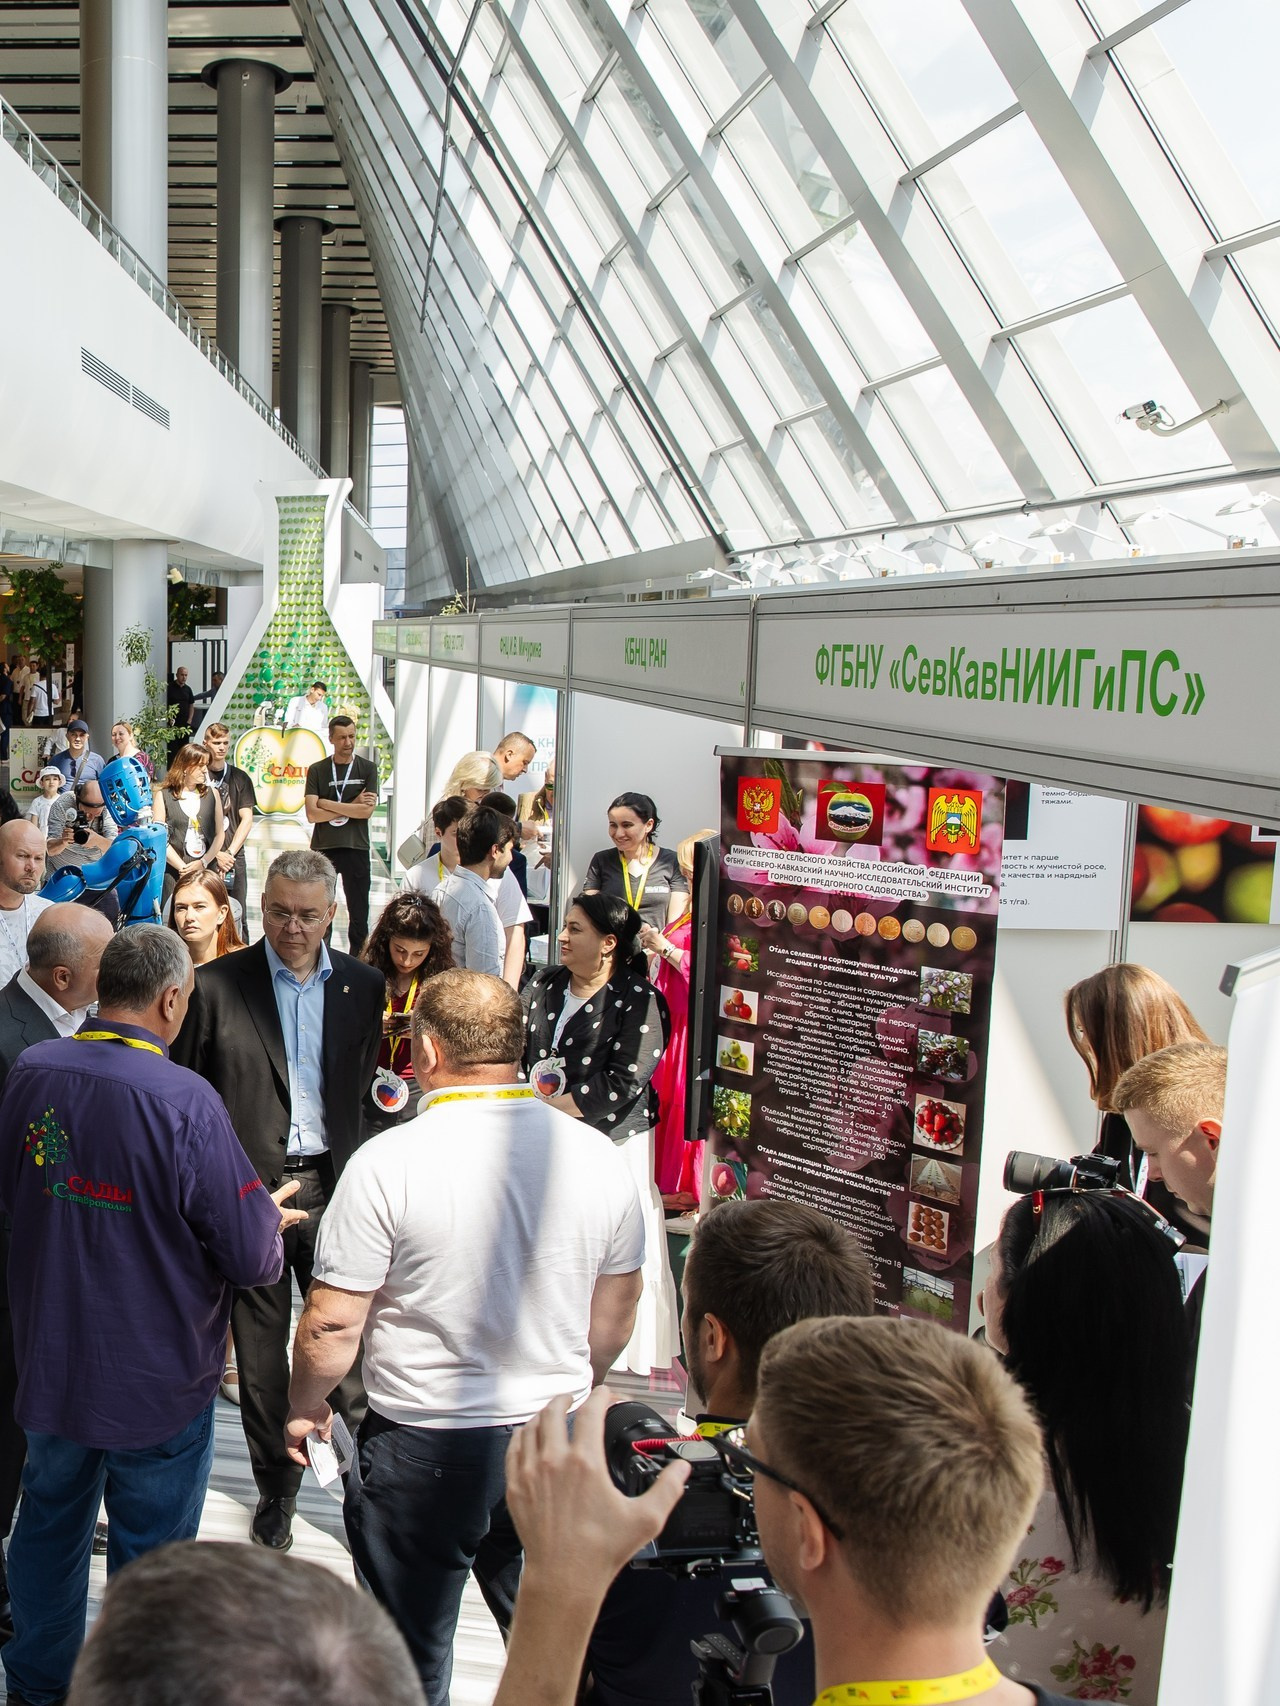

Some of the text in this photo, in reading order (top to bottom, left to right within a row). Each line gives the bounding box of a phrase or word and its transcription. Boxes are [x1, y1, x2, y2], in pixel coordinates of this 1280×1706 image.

[624, 638, 667, 672] КБНЦ РАН
[815, 644, 1206, 717] ФГБНУ «СевКавНИИГиПС»
[726, 857, 989, 895] ФГБНУ «СЕВЕРО-КАВКАЗСКИЙ НАУЧНО-ИССЛЕДОВАТЕЛЬСКИЙ ИНСТИТУТ
[732, 847, 980, 882] МИНИСТЕРСТВО СЕЛЬСКОГО ХОЗЯЙСТВА РОССИЙСКОЙ ФЕДЕРАЦИИ
[771, 873, 926, 898] ГОРНОГО ПРЕДГОРНОГО САДОВОДСТВА»
[769, 945, 918, 977] Отдел селекции сортоизучения плодовых,
[786, 958, 898, 982] ягодных орехоплодных культур
[766, 970, 812, 984] Исследования
[824, 981, 856, 992] селекции
[863, 987, 918, 1003] сортоизучению
[777, 980, 812, 992] проводятся
[823, 989, 866, 1002] следующим
[791, 991, 831, 1004] семечковые
[837, 1000, 862, 1011] яблоня,
[764, 994, 802, 1007] косточковые
[809, 1003, 830, 1012] слива,
[856, 1012, 887, 1024] черешня,
[889, 1019, 917, 1029] персик,
[773, 1012, 820, 1027] орехоплодные
[826, 1023, 854, 1035] грецкий
[855, 1028, 873, 1039] орех,
[804, 1010, 835, 1022] абрикос,
[762, 1033, 914, 1072] Селекционерами института выведено свыше
[768, 1019, 793, 1030] ягодные
[835, 1033, 877, 1048] смородина,
[879, 1042, 909, 1054] малина,
[800, 1033, 837, 1047] крыжовник,
[766, 1052, 812, 1066] орехоплодных
[846, 1070, 907, 1088] государственное
[767, 1060, 801, 1073] испытание
[803, 1068, 836, 1080] передано
[837, 1075, 859, 1085] более
[869, 1082, 896, 1094] сортов,
[779, 1047, 838, 1065] высокоурожайных
[839, 1060, 863, 1069] сортов
[864, 1066, 897, 1077] плодовых
[763, 1067, 788, 1078] которых
[789, 1072, 838, 1090] районированы
[849, 1088, 878, 1100] южному
[880, 1095, 909, 1107] региону
[775, 1077, 799, 1089] России
[809, 1086, 833, 1096] сортов,
[853, 1096, 877, 1108] яблони
[778, 1087, 875, 1115] груши сливы персика
[792, 1106, 821, 1119] грецкого
[822, 1114, 843, 1125] ореха
[809, 1102, 844, 1115] земляники
[761, 1105, 906, 1149] Отделом выделено около 60 элитных форм
[765, 1116, 794, 1127] плодовых
[795, 1122, 820, 1135] культур,
[822, 1130, 848, 1142] изучено
[849, 1137, 871, 1148] более
[872, 1142, 885, 1151] 750
[776, 1127, 886, 1160] гибридных сеянцев свыше 1500
[802, 1142, 856, 1161] сортообразцов.
[757, 1144, 904, 1192] Отдел механизации трудоемких процессов
[773, 1160, 891, 1196] горном предгорном садоводстве
[68, 1176, 132, 1203] САДЫ
[763, 1180, 806, 1196] изготовление
[812, 1193, 851, 1210] проведения
[852, 1205, 893, 1223] апробаций
[773, 1174, 793, 1185] Отдел
[794, 1180, 839, 1198] осуществляет
[760, 1186, 786, 1200] опытных
[787, 1195, 818, 1210] образцов
[819, 1204, 896, 1232] сельскохозяйственной
[839, 1219, 884, 1237] предгорного
[894, 1260, 901, 1268] 18
